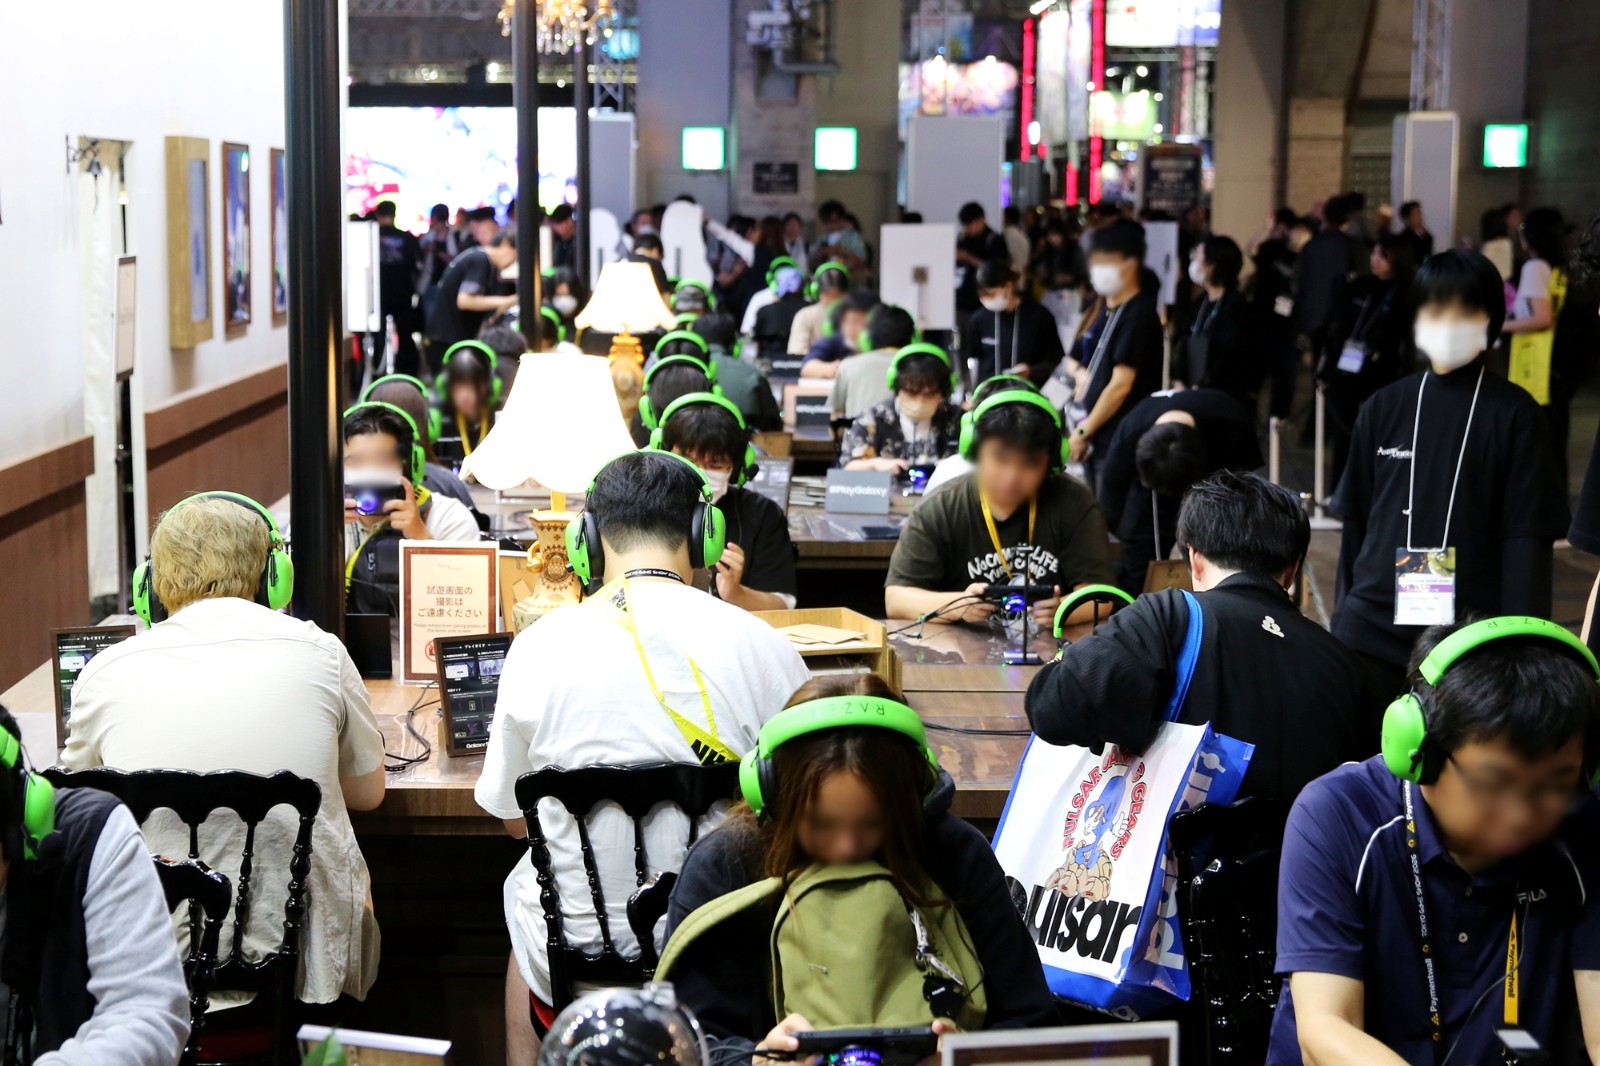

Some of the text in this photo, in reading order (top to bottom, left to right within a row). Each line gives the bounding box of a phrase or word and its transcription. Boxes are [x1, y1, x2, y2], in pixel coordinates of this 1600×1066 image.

[829, 485, 887, 497] #PlayGalaxy
[1014, 557, 1047, 580] CMP
[427, 585, 473, 595] 試遊画面の
[436, 597, 464, 607] 撮影は
[418, 608, 483, 618] ご遠慮ください
[1062, 765, 1103, 851] PULSAR
[1110, 781, 1148, 862] GEARS
[1413, 874, 1423, 896] SHOW
[1417, 896, 1425, 914] GAME
[1516, 888, 1548, 904] FILA
[1419, 914, 1428, 938] TOKYO
[1424, 957, 1438, 1013] Paymentwall
